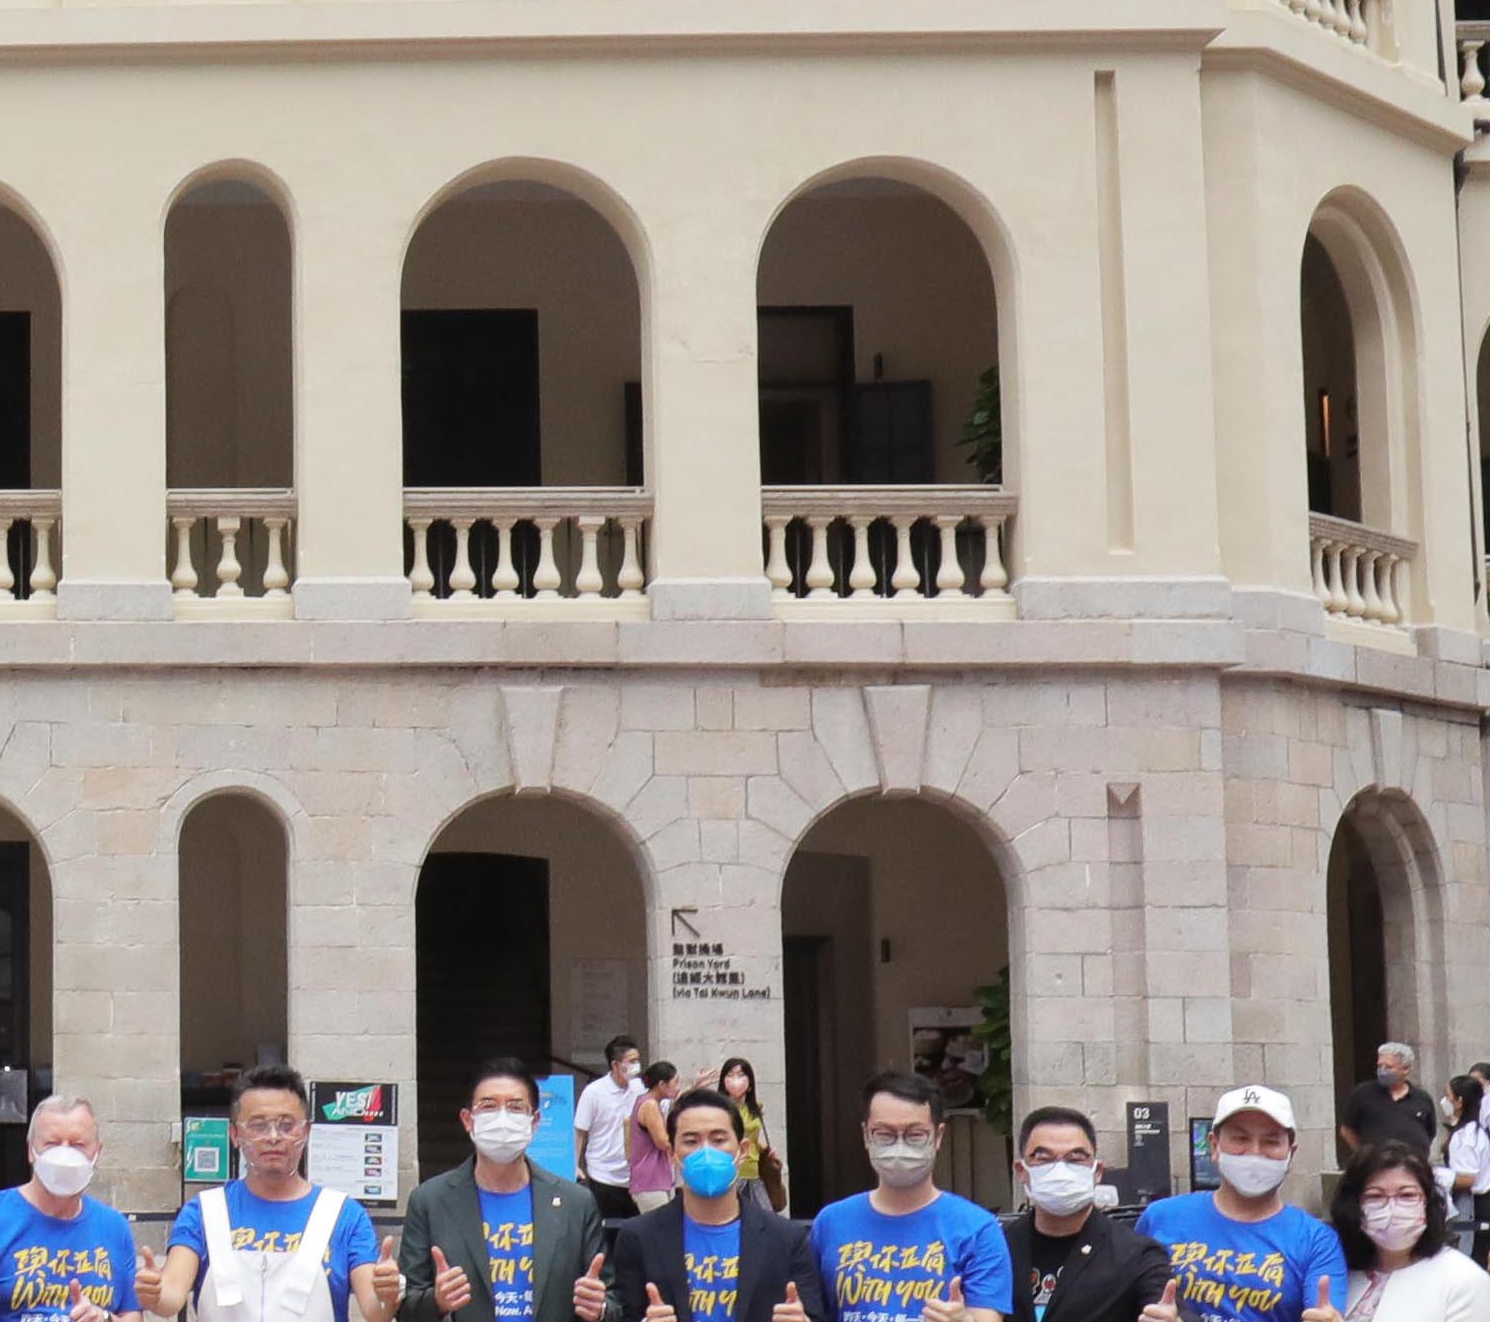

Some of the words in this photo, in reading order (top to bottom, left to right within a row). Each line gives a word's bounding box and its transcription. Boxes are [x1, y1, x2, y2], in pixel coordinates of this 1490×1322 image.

[673, 959, 704, 969] Prison
[707, 959, 730, 969] Yard
[693, 988, 708, 997] Tai
[712, 988, 739, 998] Kwun
[742, 986, 770, 999] Lane)
[1134, 1108, 1150, 1119] 03
